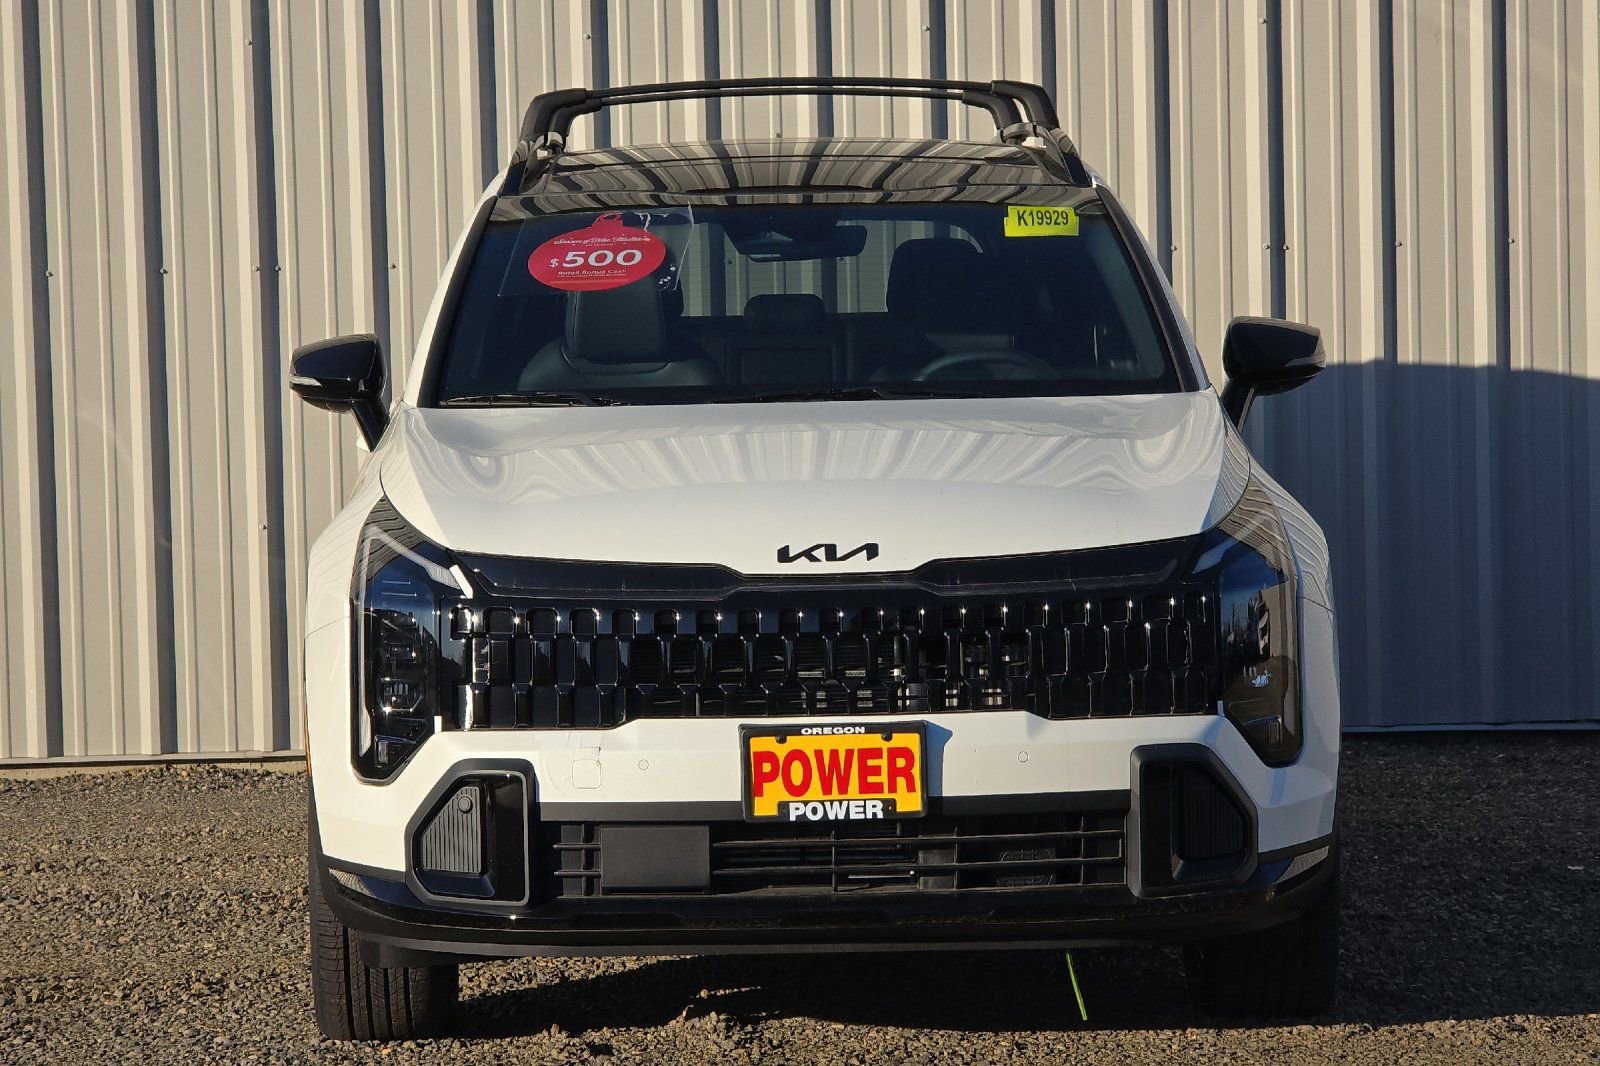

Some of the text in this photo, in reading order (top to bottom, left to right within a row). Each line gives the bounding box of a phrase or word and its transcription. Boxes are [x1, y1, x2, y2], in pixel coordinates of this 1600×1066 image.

[1017, 209, 1069, 226] K19929
[548, 249, 642, 268] $500
[801, 726, 865, 735] OREGON
[753, 747, 916, 798] POWER
[789, 799, 884, 822] POWER
